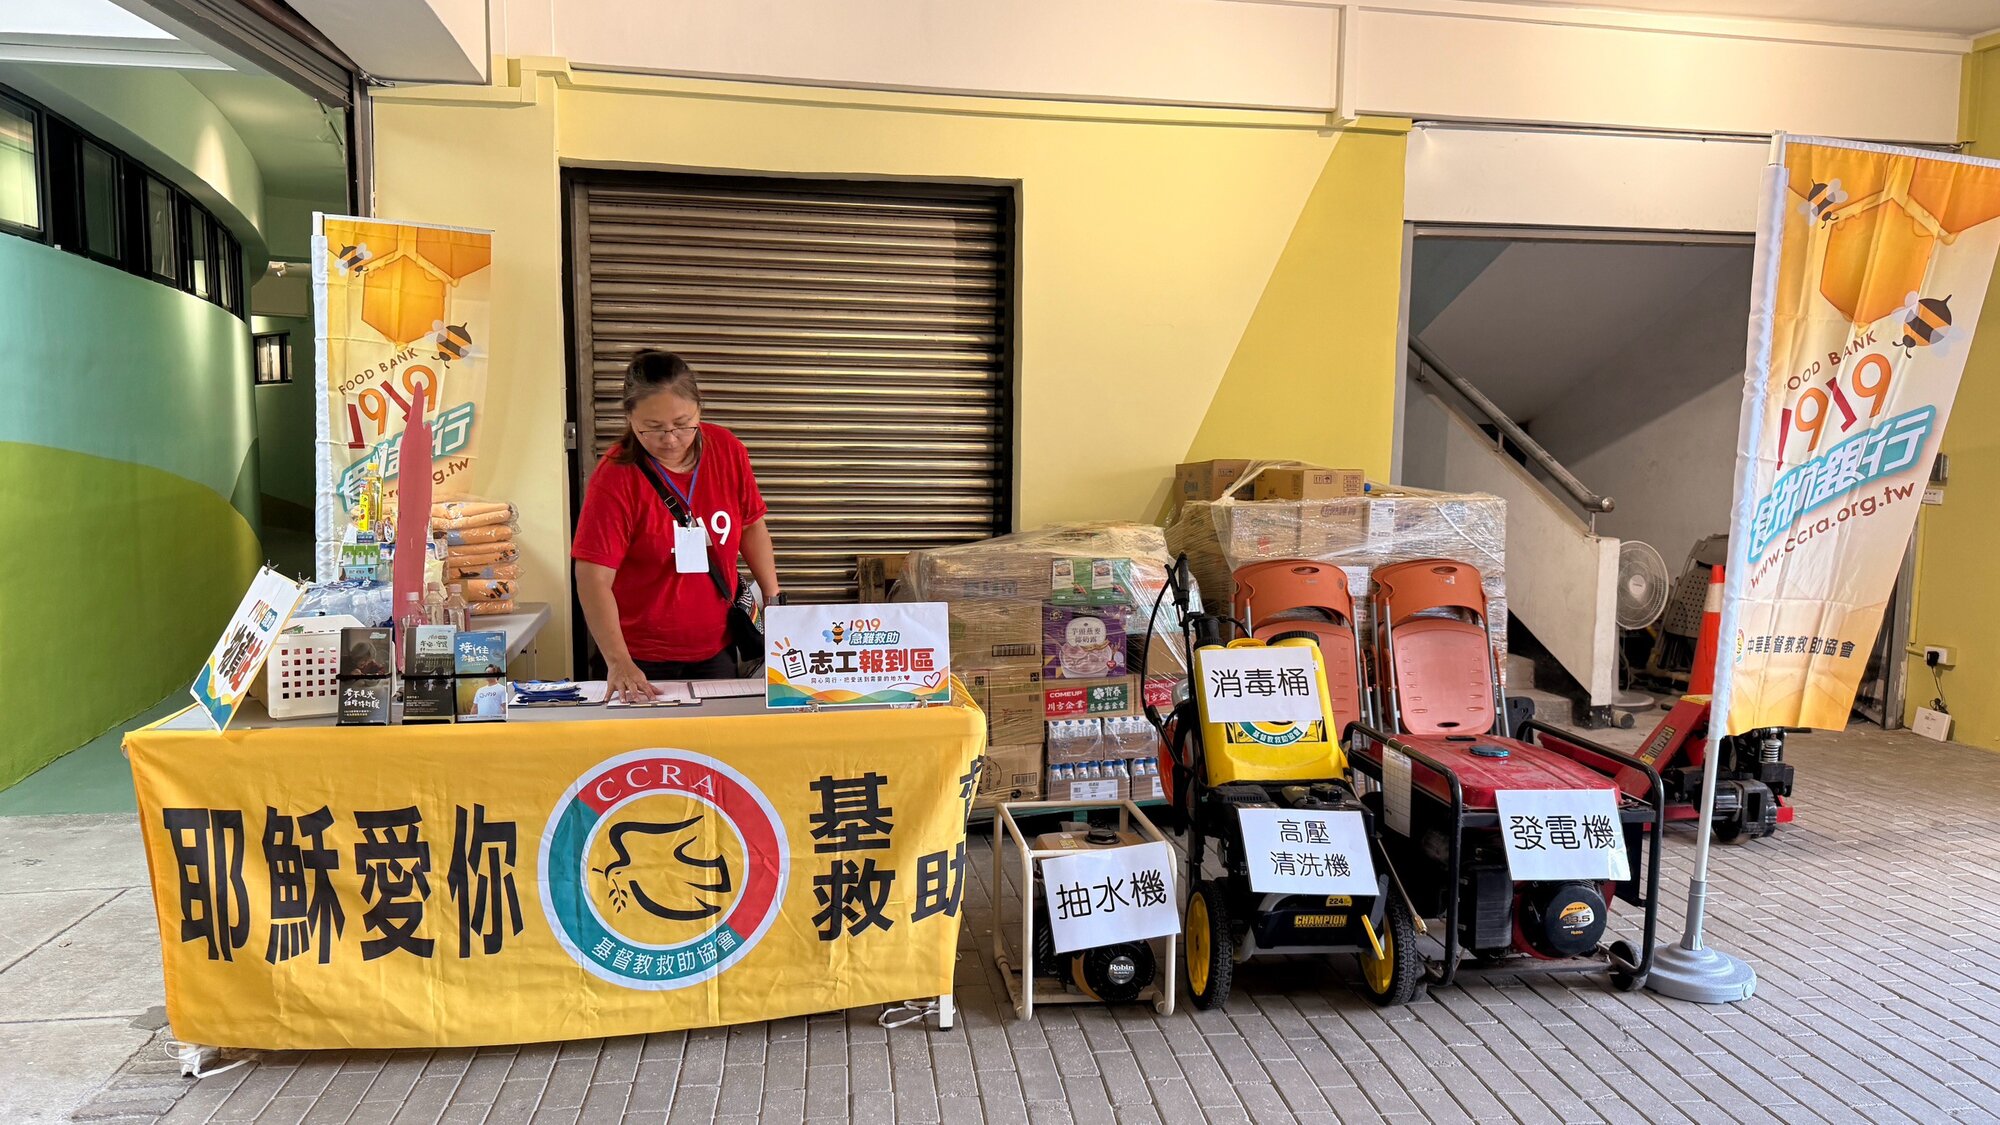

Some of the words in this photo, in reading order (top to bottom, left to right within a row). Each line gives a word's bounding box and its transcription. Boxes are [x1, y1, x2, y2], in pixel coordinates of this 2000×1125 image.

[1828, 330, 1878, 366] BANK
[338, 368, 375, 396] FOOD
[379, 347, 419, 373] BANK
[1777, 353, 1893, 471] 1919
[1750, 481, 1916, 589] www.ccra.org.tw
[849, 617, 881, 632] 1919
[850, 631, 900, 645] 急難救助
[809, 647, 935, 675] 志工報到區
[1049, 690, 1083, 699] COMEUP
[1210, 666, 1311, 699] 消毒桶
[1047, 699, 1086, 712] 川方企業
[594, 763, 717, 802] CCRA
[1276, 818, 1332, 845] 高壓
[1509, 813, 1617, 851] 發電機
[1269, 850, 1351, 878] 清洗機
[162, 802, 524, 965] 耶穌愛你
[1055, 869, 1167, 920] 抽水機
[1294, 914, 1348, 925] CHAMPION
[590, 929, 737, 977] 基督教救助協會
